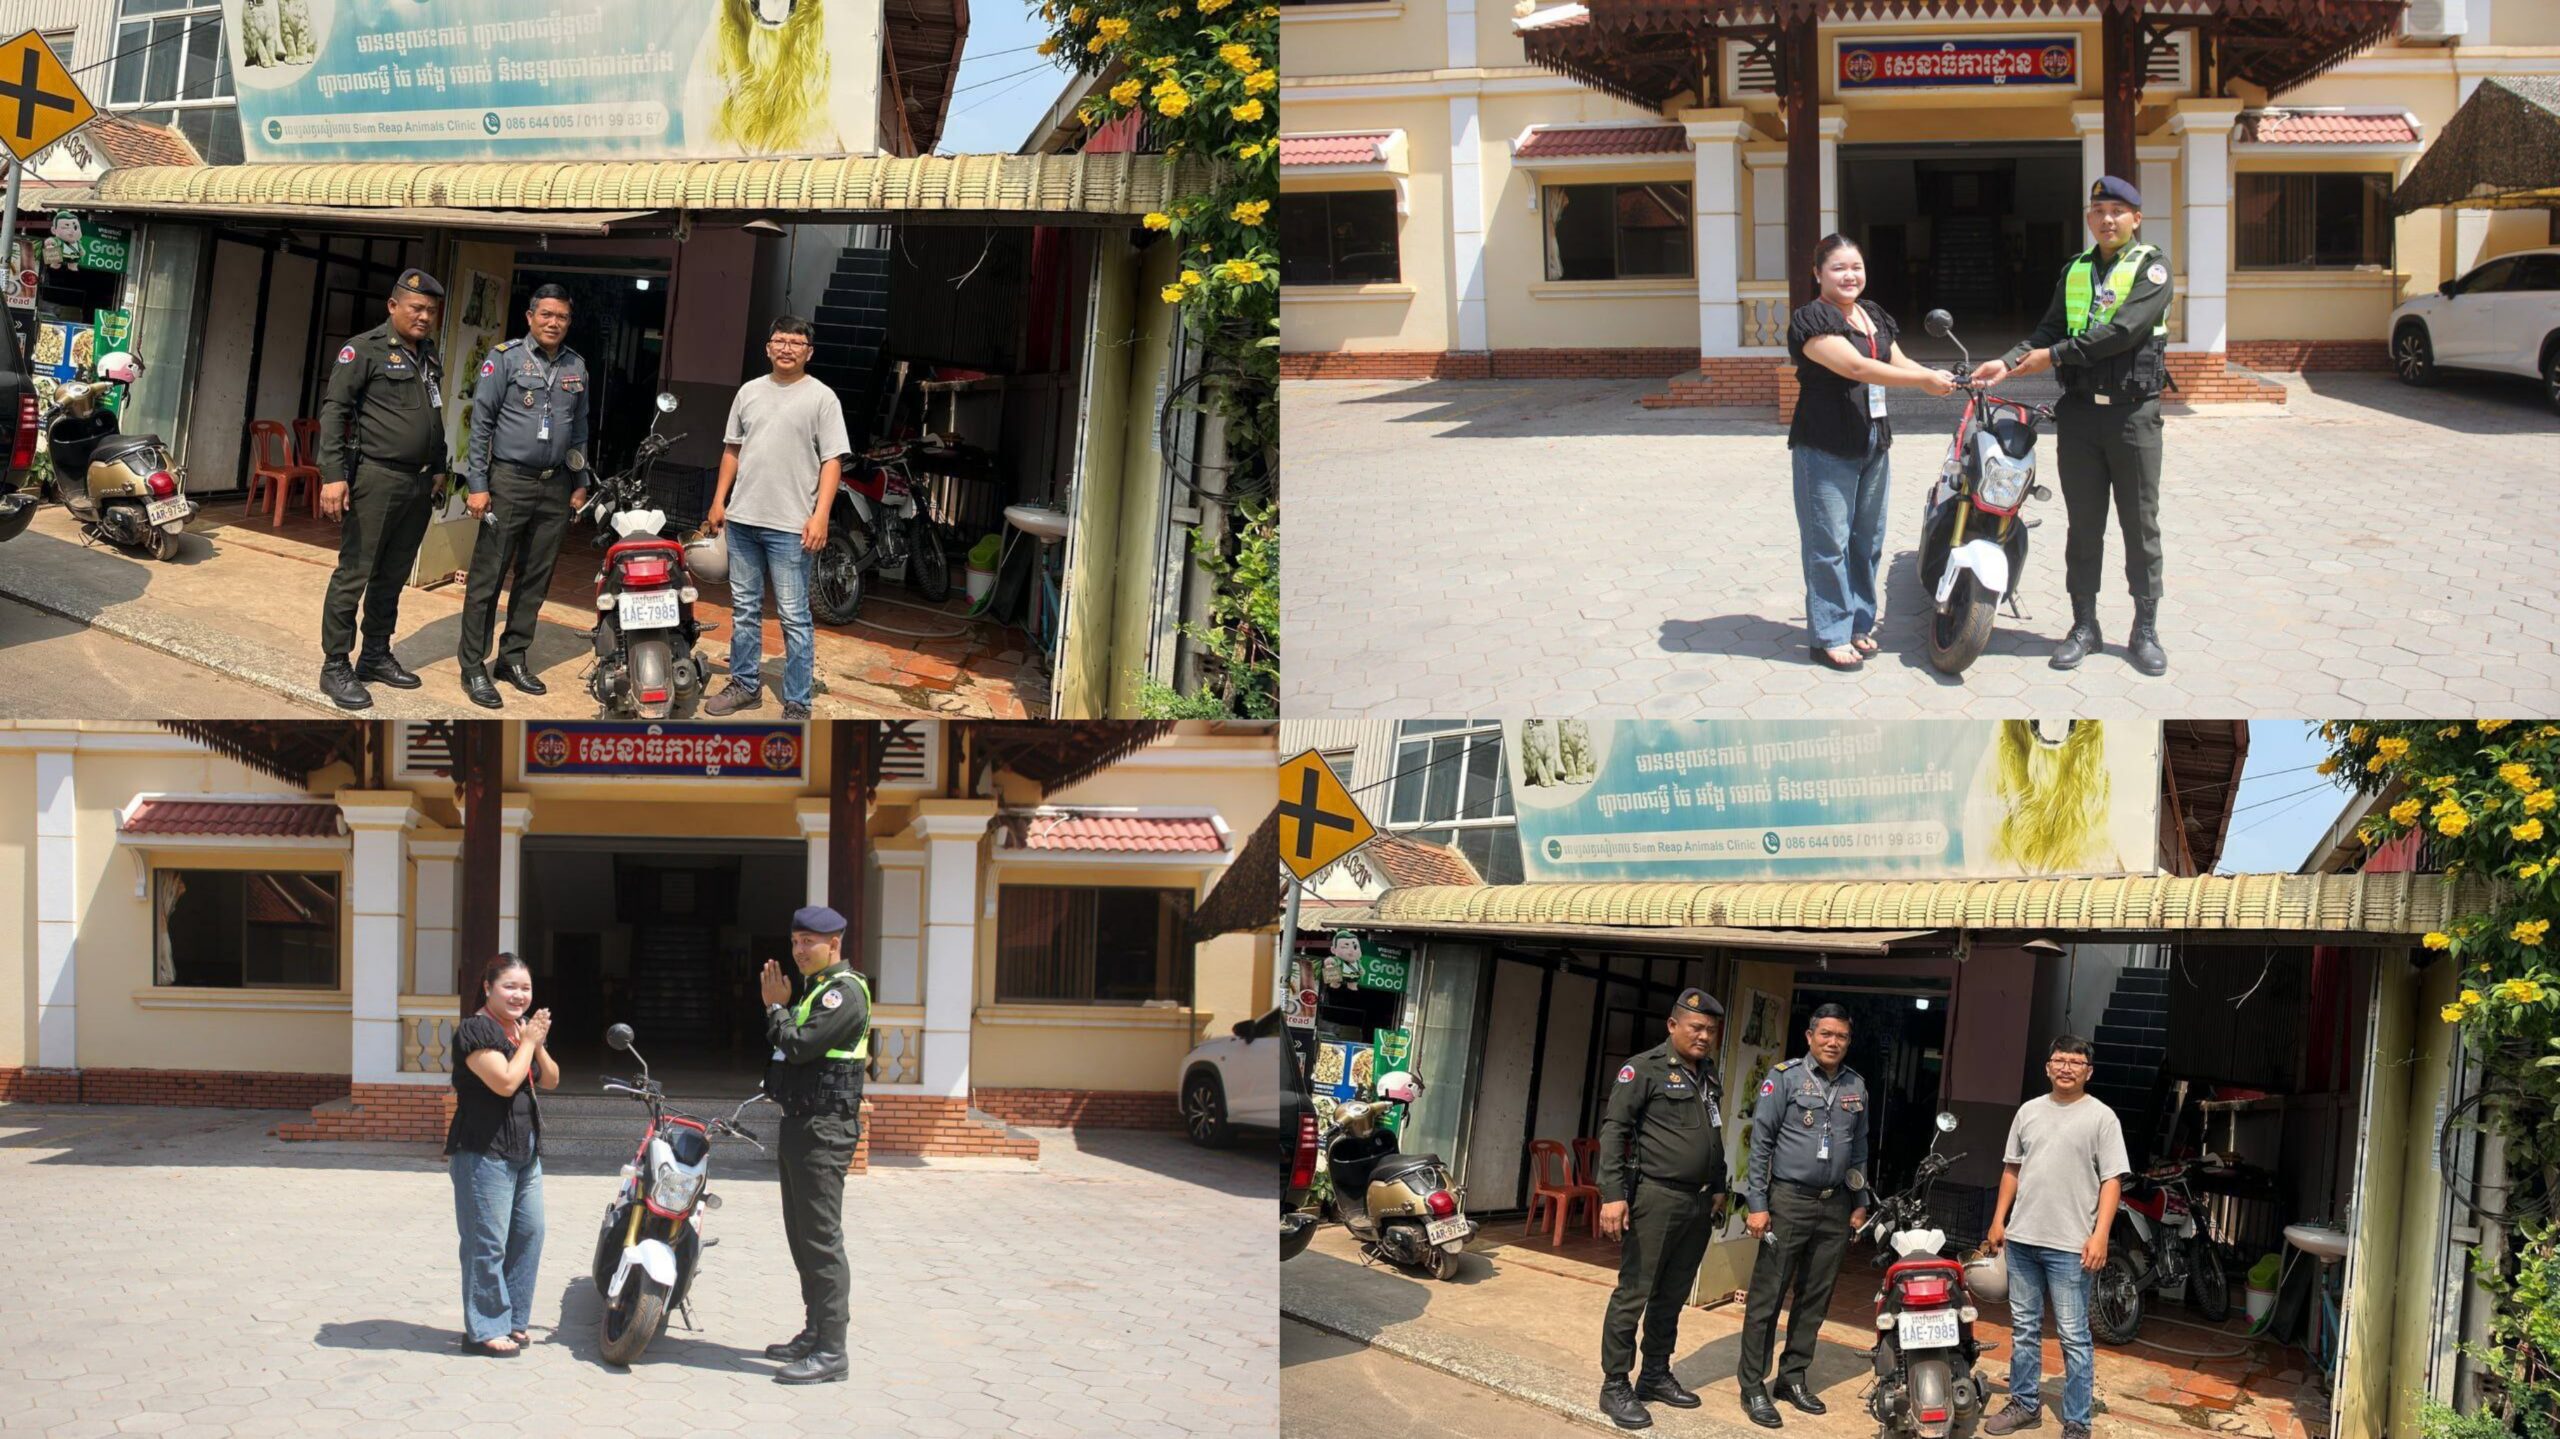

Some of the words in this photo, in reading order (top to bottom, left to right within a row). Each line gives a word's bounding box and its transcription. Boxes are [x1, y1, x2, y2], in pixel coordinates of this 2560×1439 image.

[1884, 42, 2032, 84] សេនាធិការដ្ឋាន
[353, 123, 376, 134] Siem
[378, 122, 403, 134] Reap
[405, 121, 445, 132] Animals
[447, 119, 476, 131] Clinic
[506, 117, 526, 130] 086
[529, 116, 550, 129] 644
[553, 115, 574, 128] 005
[584, 114, 604, 127] 011
[609, 113, 623, 126] 99
[628, 113, 642, 126] 83
[646, 112, 661, 125] 67
[89, 240, 125, 257] Grab
[87, 254, 123, 270] Food
[5, 296, 30, 305] read
[151, 502, 187, 522] 1AR-9752
[622, 603, 676, 622] 1AE-7985
[579, 724, 751, 776] សេនាធិការដ្ឋាន
[1633, 843, 1656, 854] Siem
[1658, 842, 1683, 854] Reap
[1685, 841, 1725, 852] Animals
[1727, 839, 1756, 851] Clinic
[1786, 837, 1806, 850] 086
[1809, 836, 1830, 849] 644
[1833, 835, 1854, 848] 005
[1864, 834, 1884, 847] 011
[1889, 833, 1903, 846] 99
[1908, 833, 1922, 846] 83
[1926, 832, 1941, 845] 67
[1369, 959, 1405, 976] Grab
[1367, 973, 1403, 989] Food
[1285, 1015, 1310, 1024] read
[1431, 1221, 1467, 1241] 1AR-9752
[1902, 1322, 1956, 1341] 1AE-7985
